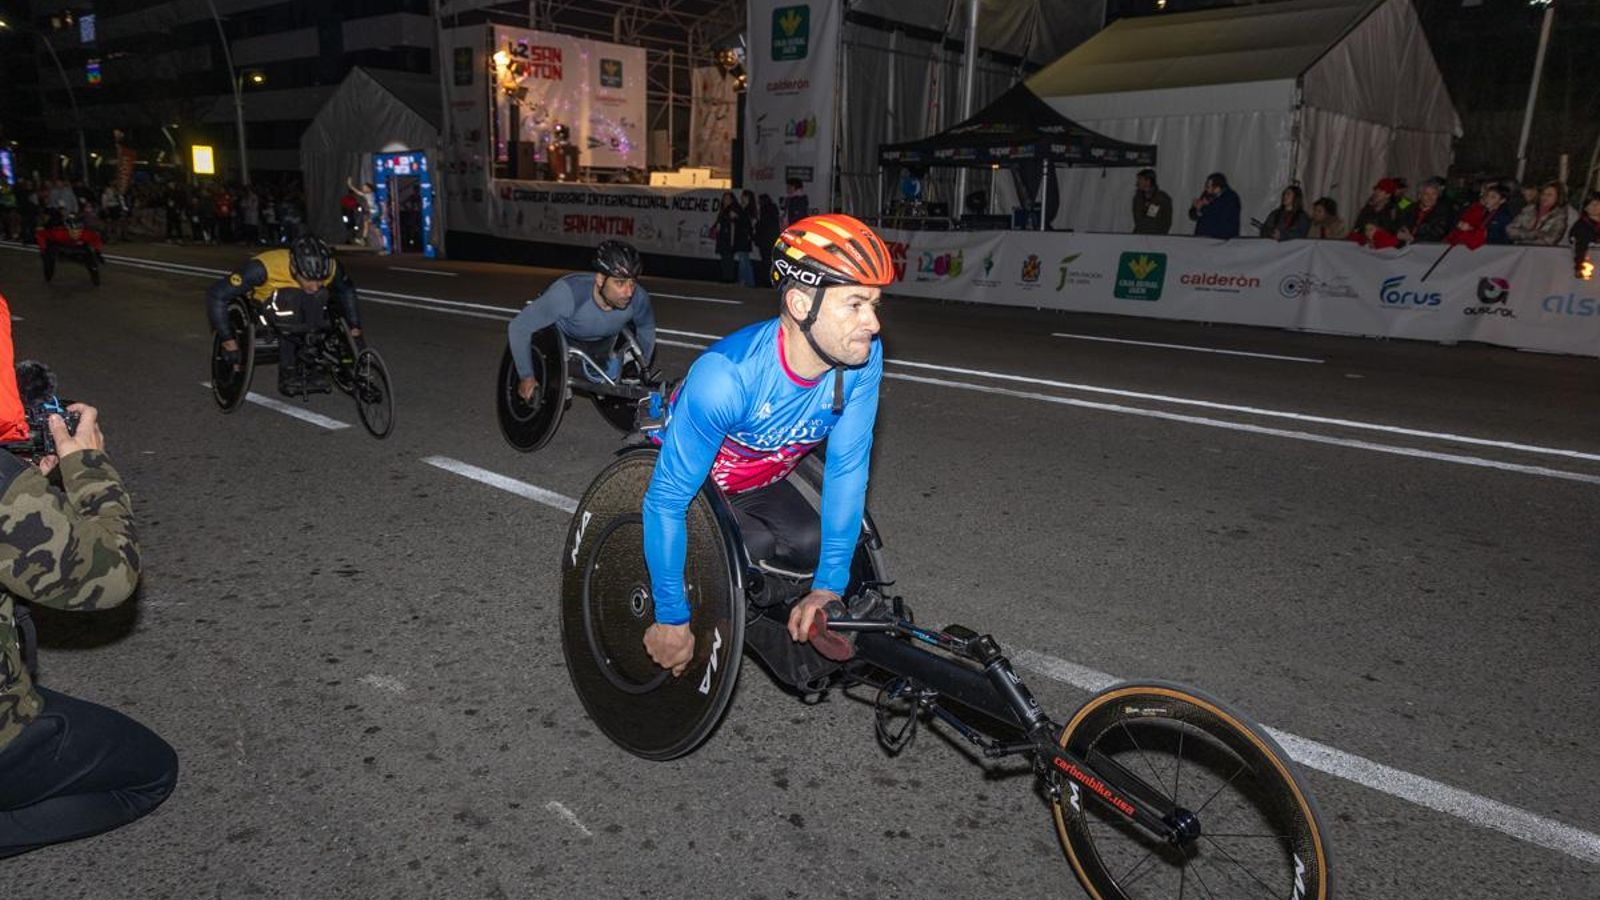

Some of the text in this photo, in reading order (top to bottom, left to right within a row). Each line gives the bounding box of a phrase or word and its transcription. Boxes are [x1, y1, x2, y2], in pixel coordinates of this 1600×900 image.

[531, 46, 562, 63] SAN
[672, 197, 708, 212] NOCHE
[1542, 293, 1600, 316] als
[1053, 756, 1136, 816] carbonbike.usa
